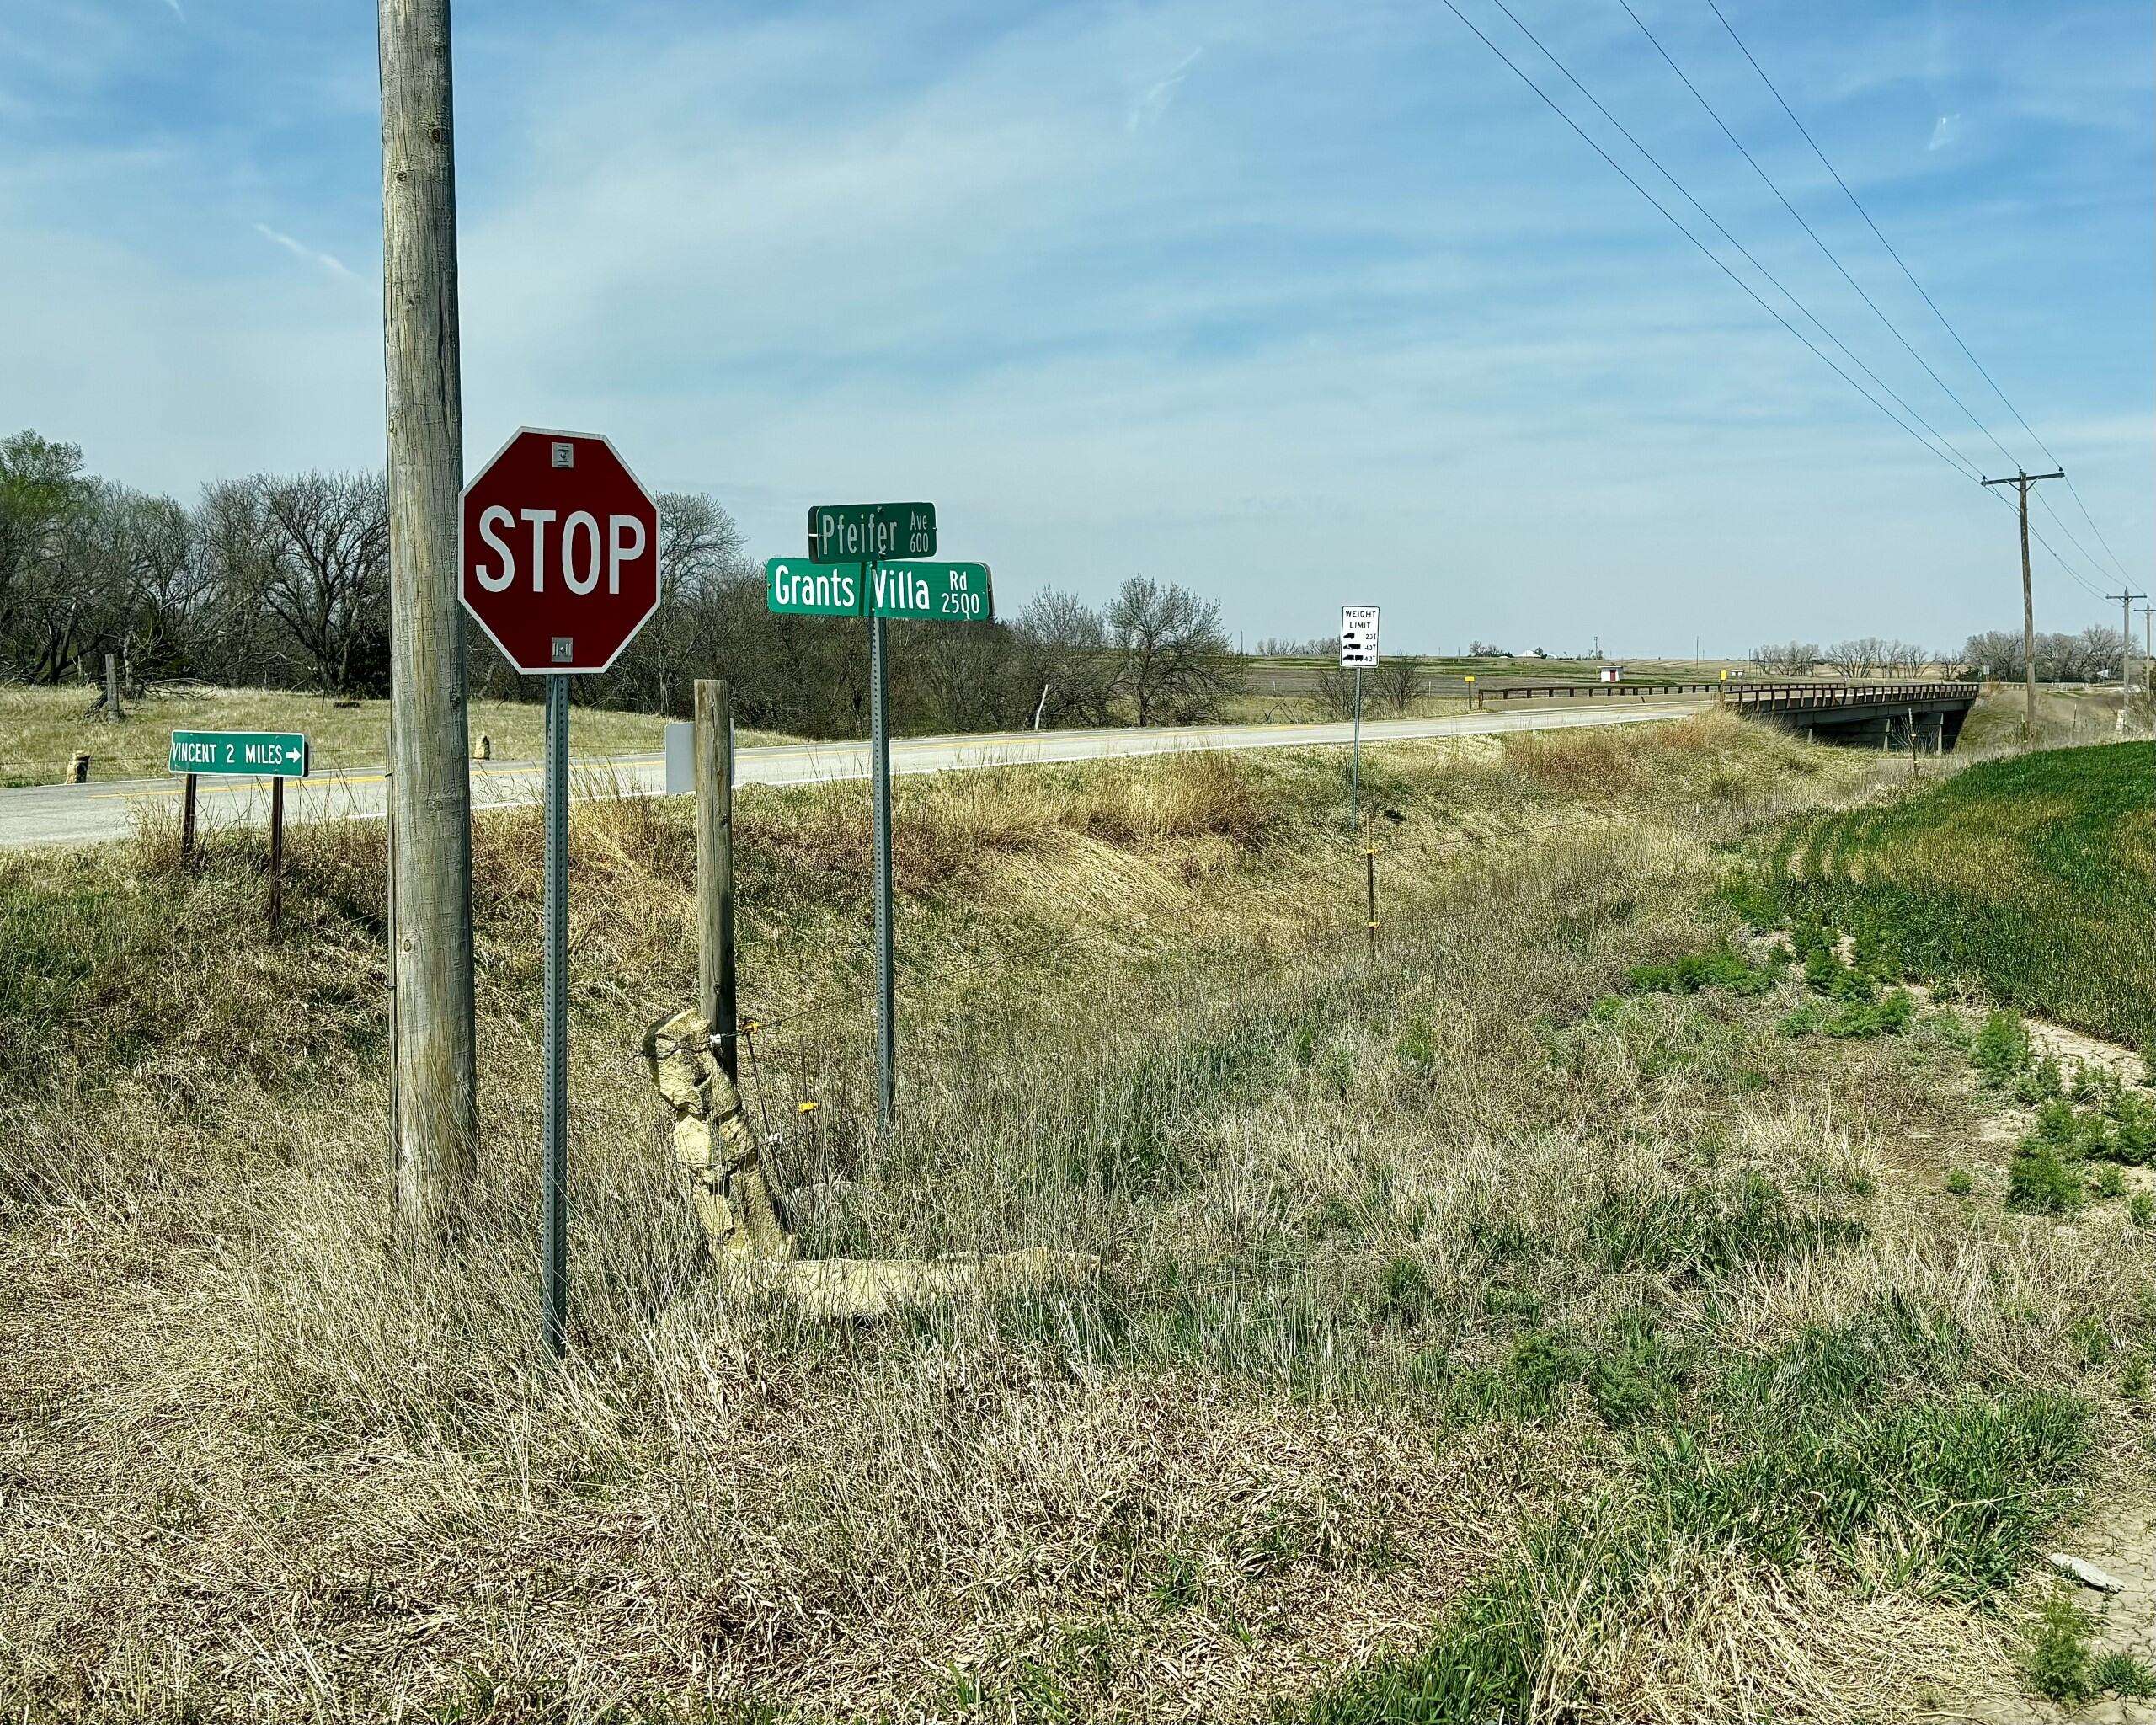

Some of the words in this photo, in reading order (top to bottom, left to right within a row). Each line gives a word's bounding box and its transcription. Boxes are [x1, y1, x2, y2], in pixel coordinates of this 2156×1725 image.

[822, 513, 897, 555] Pfeifer
[910, 511, 927, 531] Ave
[910, 532, 929, 553] 600
[475, 505, 646, 595] STOP
[775, 564, 855, 607] Grants
[872, 569, 930, 610] Villa
[949, 570, 968, 591] Rd
[942, 592, 980, 614] 2500
[1345, 610, 1376, 618] WEIGHT
[173, 742, 217, 763] VINCENT
[226, 744, 235, 763] 2
[245, 744, 283, 765] MILES
